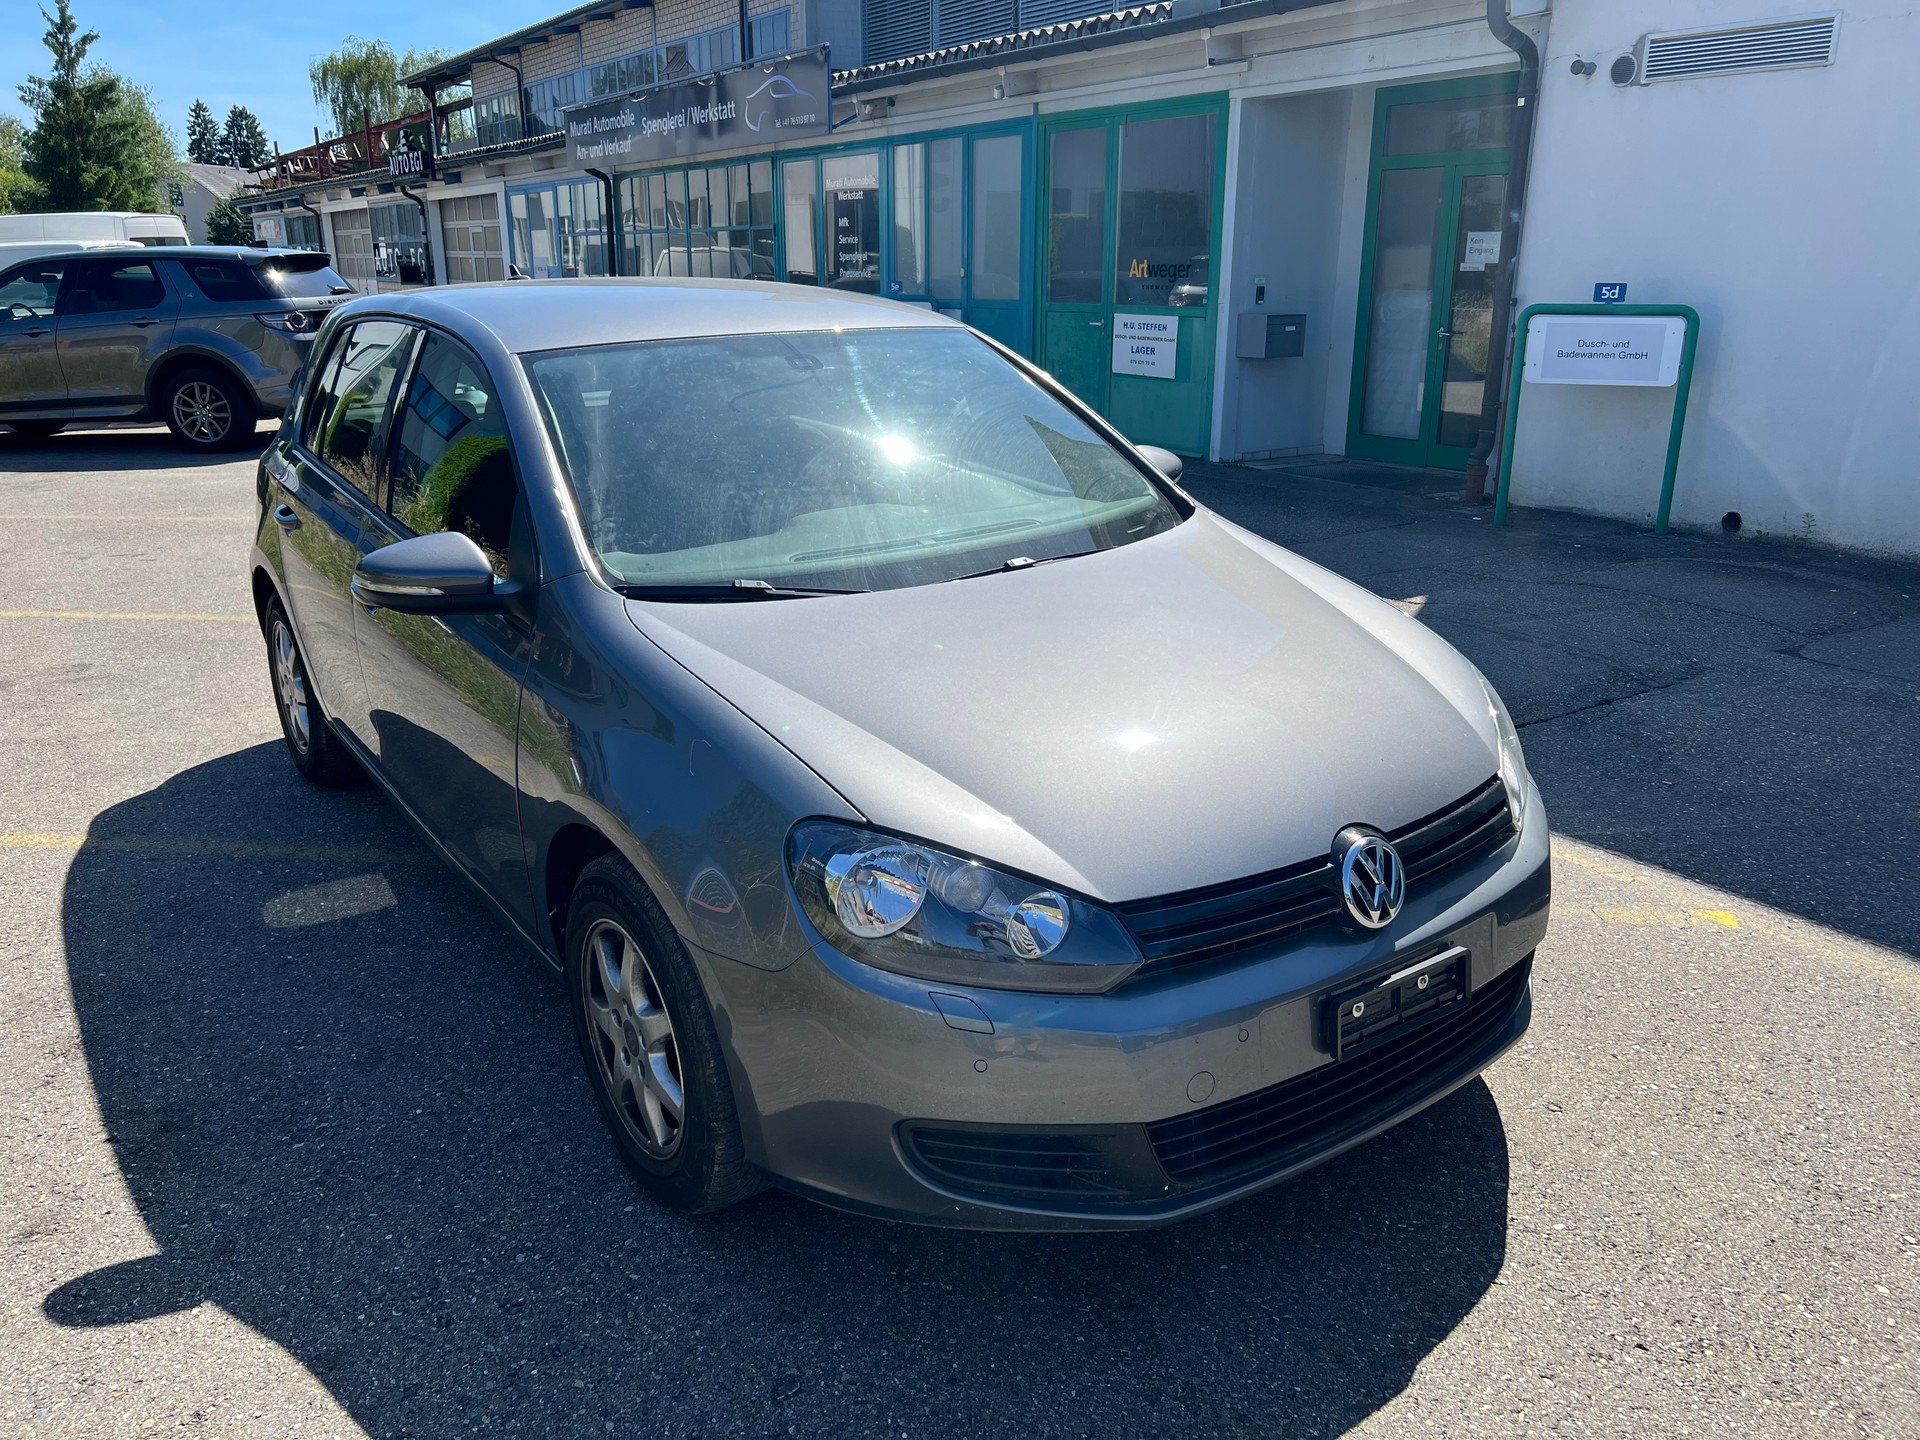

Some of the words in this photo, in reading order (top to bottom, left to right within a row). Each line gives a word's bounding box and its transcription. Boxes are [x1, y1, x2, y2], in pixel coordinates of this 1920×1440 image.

[570, 117, 593, 138] Murati
[593, 108, 635, 134] Automobile
[641, 109, 686, 138] Spenglerei
[690, 100, 736, 125] Werkstatt
[576, 144, 589, 160] An-
[589, 140, 603, 158] und
[603, 134, 632, 157] Verkauf
[389, 153, 410, 175] AUTO
[409, 151, 424, 172] EGI
[843, 175, 876, 187] Automobile
[837, 190, 864, 201] Werkstatt
[838, 234, 859, 245] Service
[1469, 236, 1484, 245] Kein
[1468, 246, 1494, 256] Eingang
[839, 251, 868, 263] Spenglerei
[839, 268, 872, 278] Pneuservice
[1128, 258, 1192, 283] Artweger
[1600, 286, 1620, 299] 5d
[1123, 321, 1136, 330] H.U.
[1138, 322, 1168, 332] STEFFEN
[1577, 339, 1610, 348] Dusch-
[1612, 340, 1630, 349] und
[1130, 345, 1156, 356] LAGER
[1556, 350, 1616, 359] Badewannen
[1618, 351, 1649, 360] GmbH
